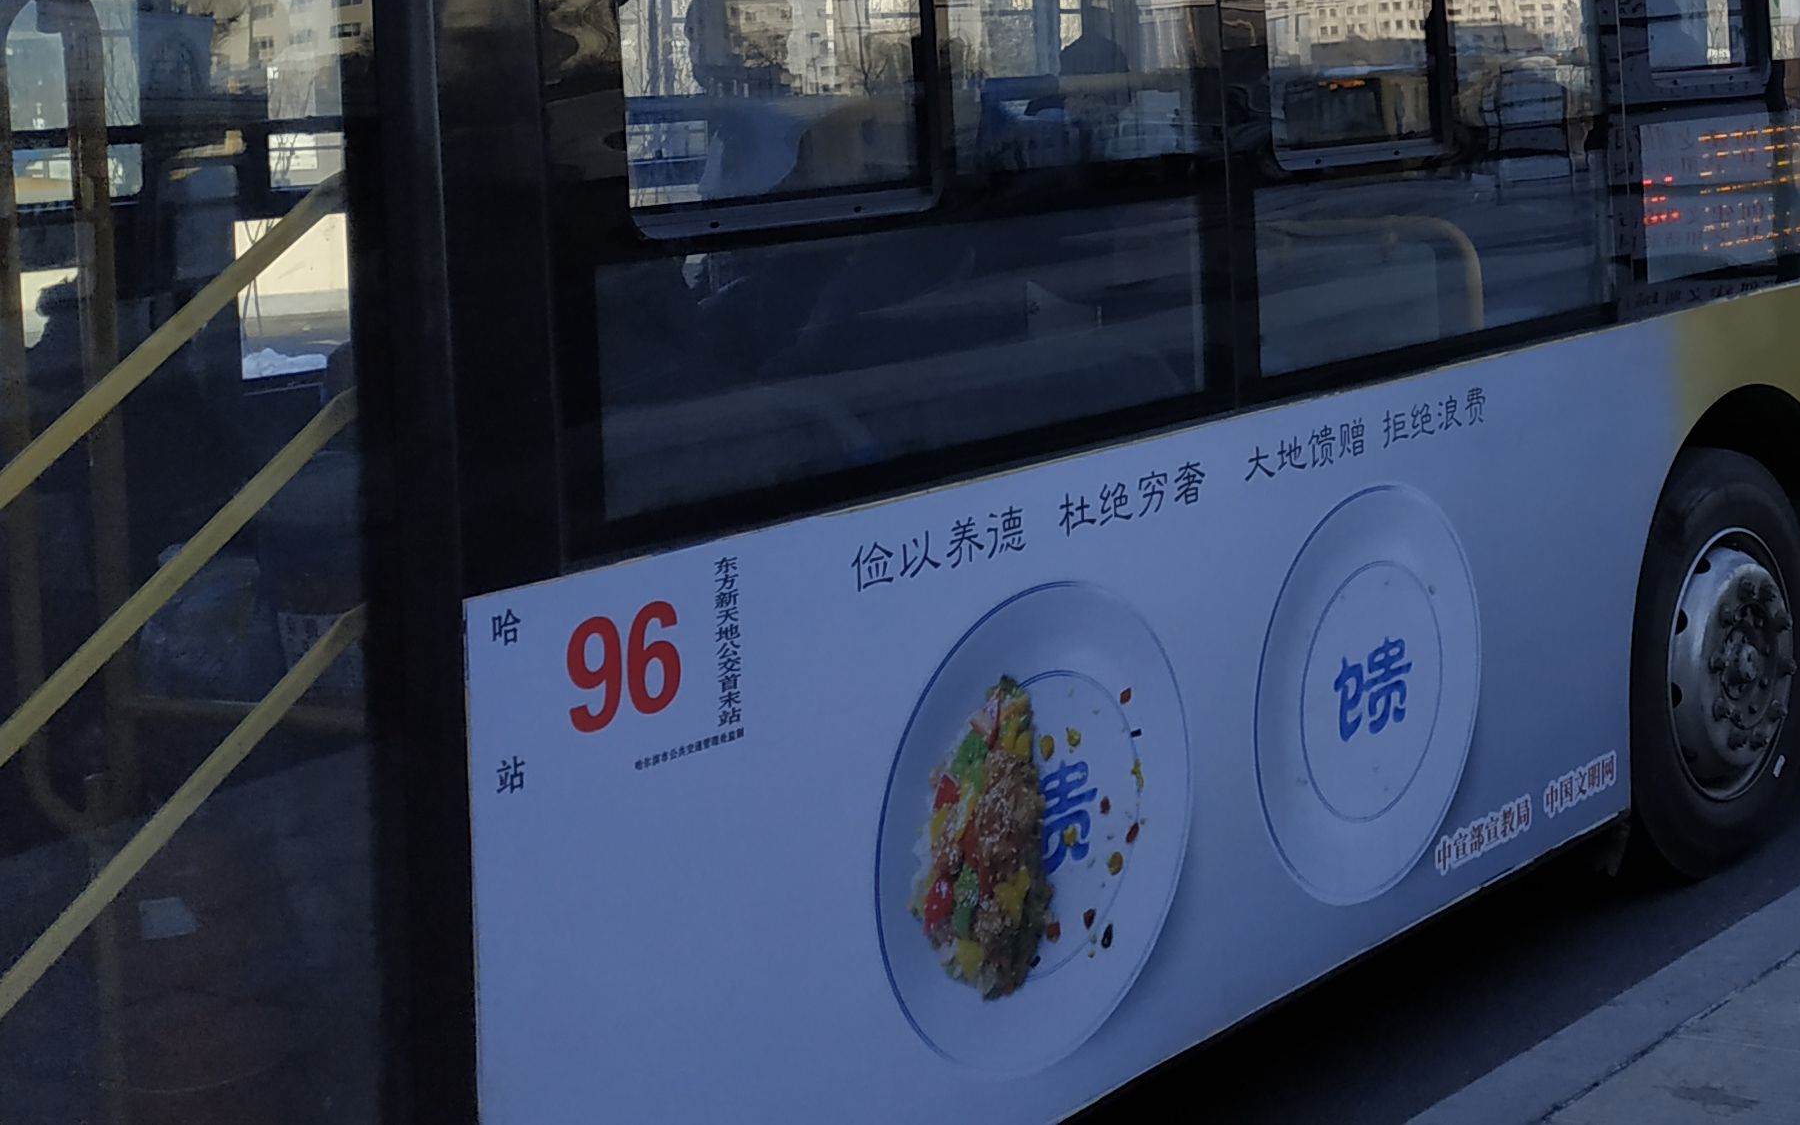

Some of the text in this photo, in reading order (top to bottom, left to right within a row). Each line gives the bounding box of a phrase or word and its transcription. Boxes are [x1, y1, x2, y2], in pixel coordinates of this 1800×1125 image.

[850, 386, 1489, 593] 俭以养德 杜绝穷奢 大地馈赠 拒绝浪费
[491, 607, 522, 647] 哈
[566, 600, 682, 734] 96
[713, 555, 745, 728] 东方新天地公交首末站
[495, 754, 527, 795] 站
[1544, 751, 1618, 818] 中国文明网
[1435, 794, 1533, 874] 中宣部宣教局
